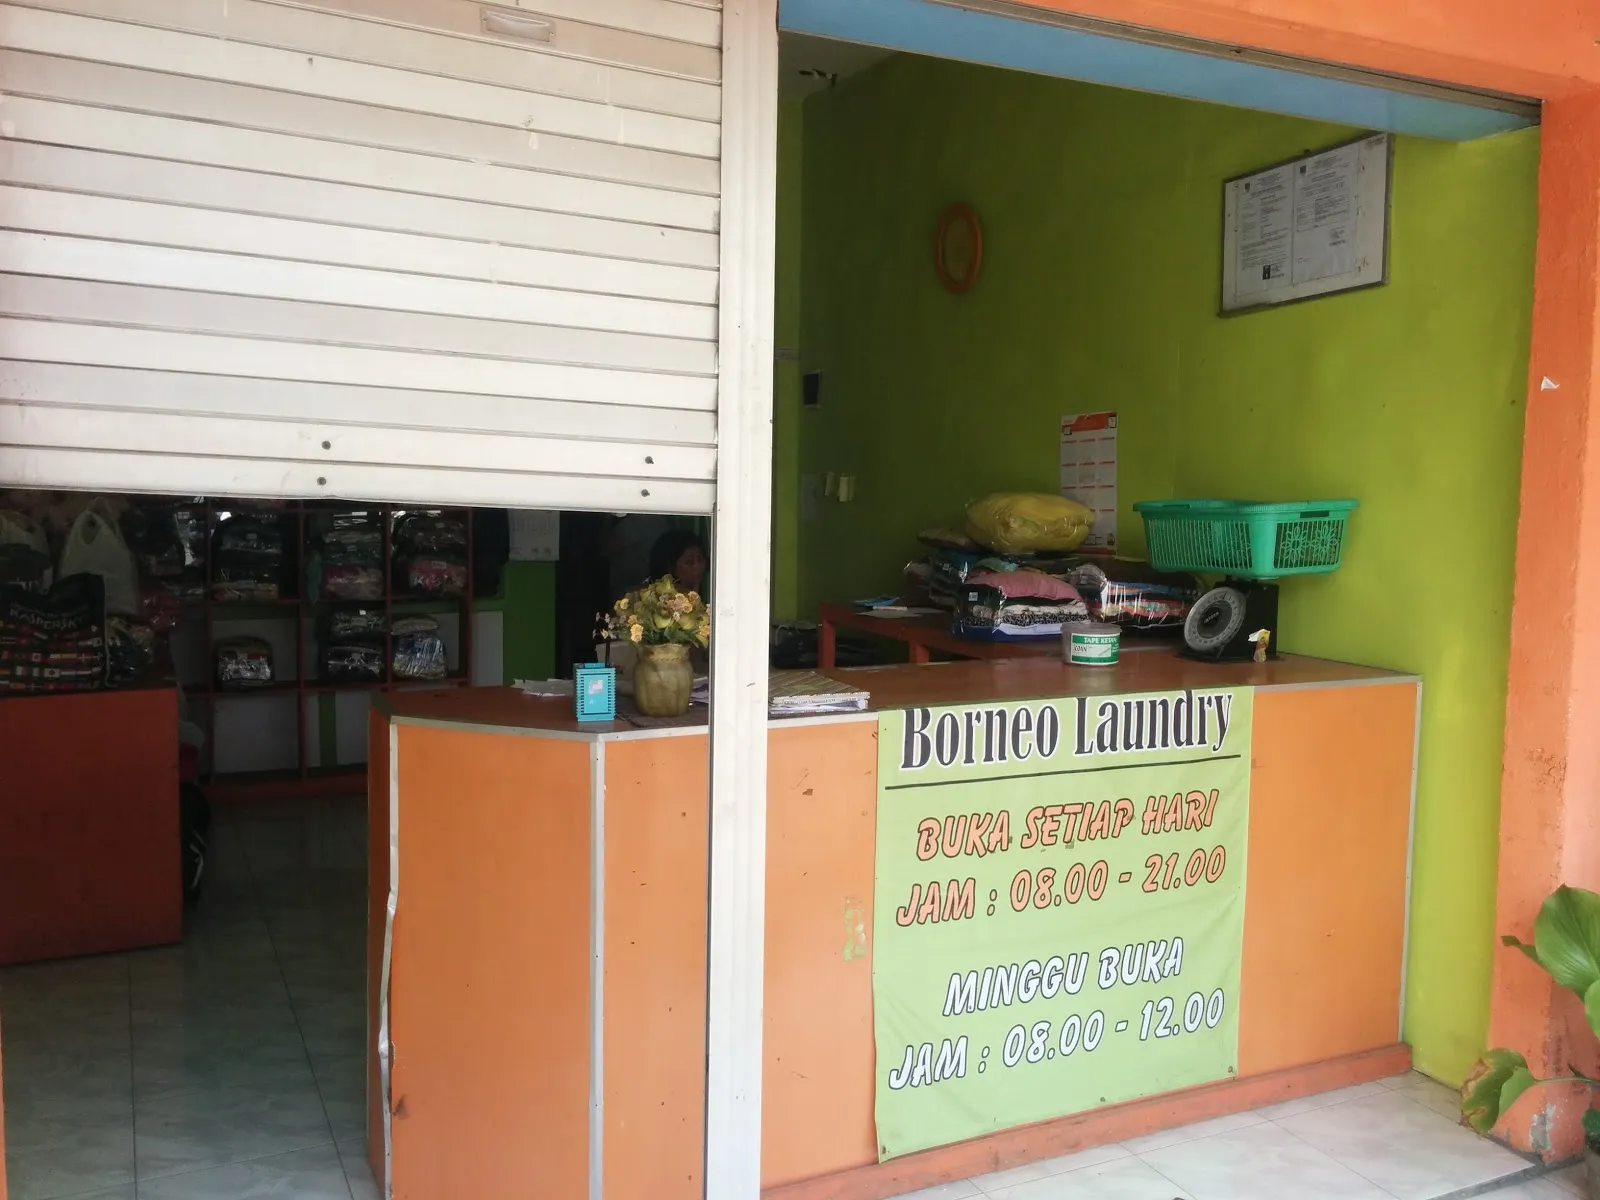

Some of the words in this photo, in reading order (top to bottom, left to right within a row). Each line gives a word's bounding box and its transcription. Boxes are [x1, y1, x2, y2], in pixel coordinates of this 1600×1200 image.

[899, 702, 1060, 771] Borneo
[1074, 690, 1234, 756] Laundry
[915, 809, 1010, 861] BUKA
[1020, 797, 1135, 850] SETIAP
[1141, 788, 1219, 835] HARI
[895, 876, 976, 927] JAM
[986, 888, 998, 916] :
[1009, 859, 1109, 912] 08.00
[1117, 871, 1133, 885] -
[1141, 844, 1226, 893] 21.00
[942, 951, 1089, 1017] MINGGU
[1098, 936, 1185, 991] BUKA
[888, 1035, 968, 1091] JAM
[977, 1045, 991, 1074] :
[1002, 1009, 1105, 1068] 08.00
[1114, 1019, 1129, 1033] -
[1138, 988, 1225, 1041] 12.00
